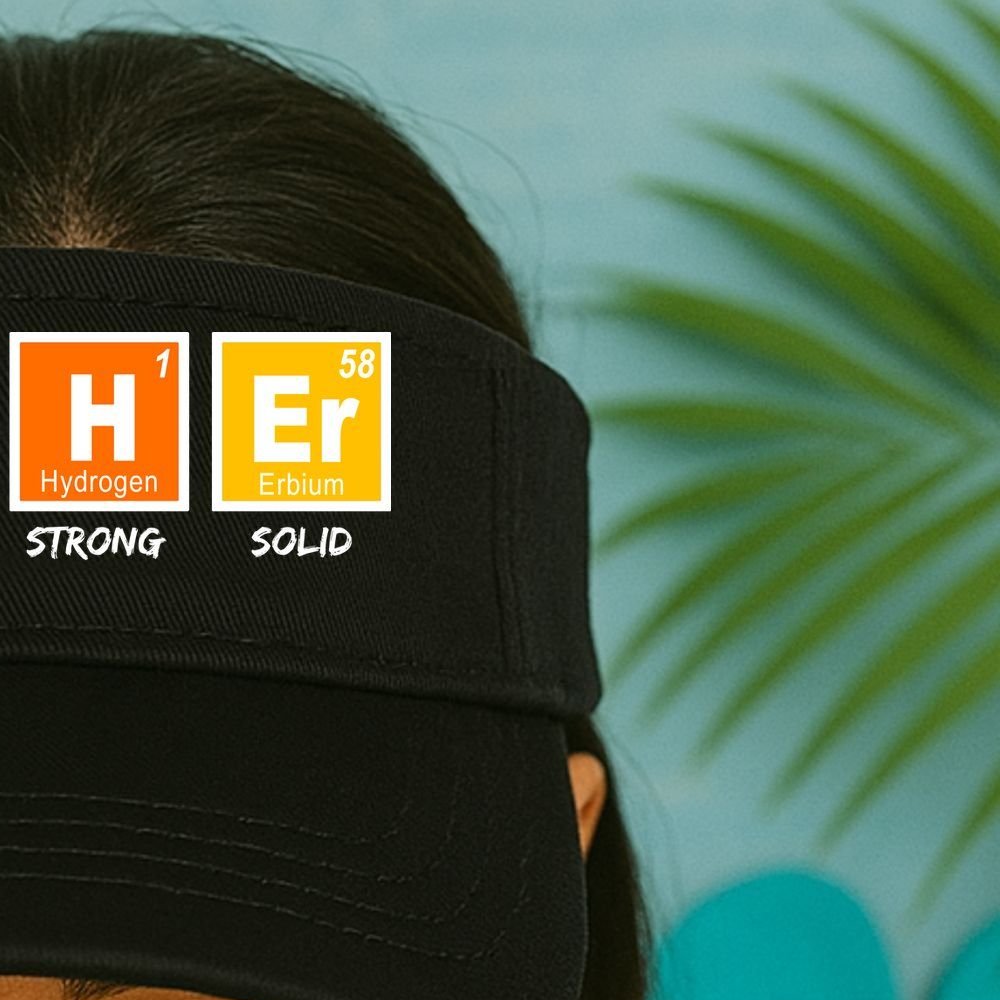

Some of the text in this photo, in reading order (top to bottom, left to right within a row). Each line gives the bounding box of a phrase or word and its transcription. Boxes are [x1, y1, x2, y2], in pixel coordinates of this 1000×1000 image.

[156, 348, 171, 378] 1
[339, 349, 375, 379] 58
[70, 374, 135, 462] H
[253, 375, 360, 463] Er
[40, 470, 157, 498] Hydrogen
[259, 472, 344, 496] Erbium
[26, 526, 167, 560] STRONG
[251, 526, 353, 558] SOLID
